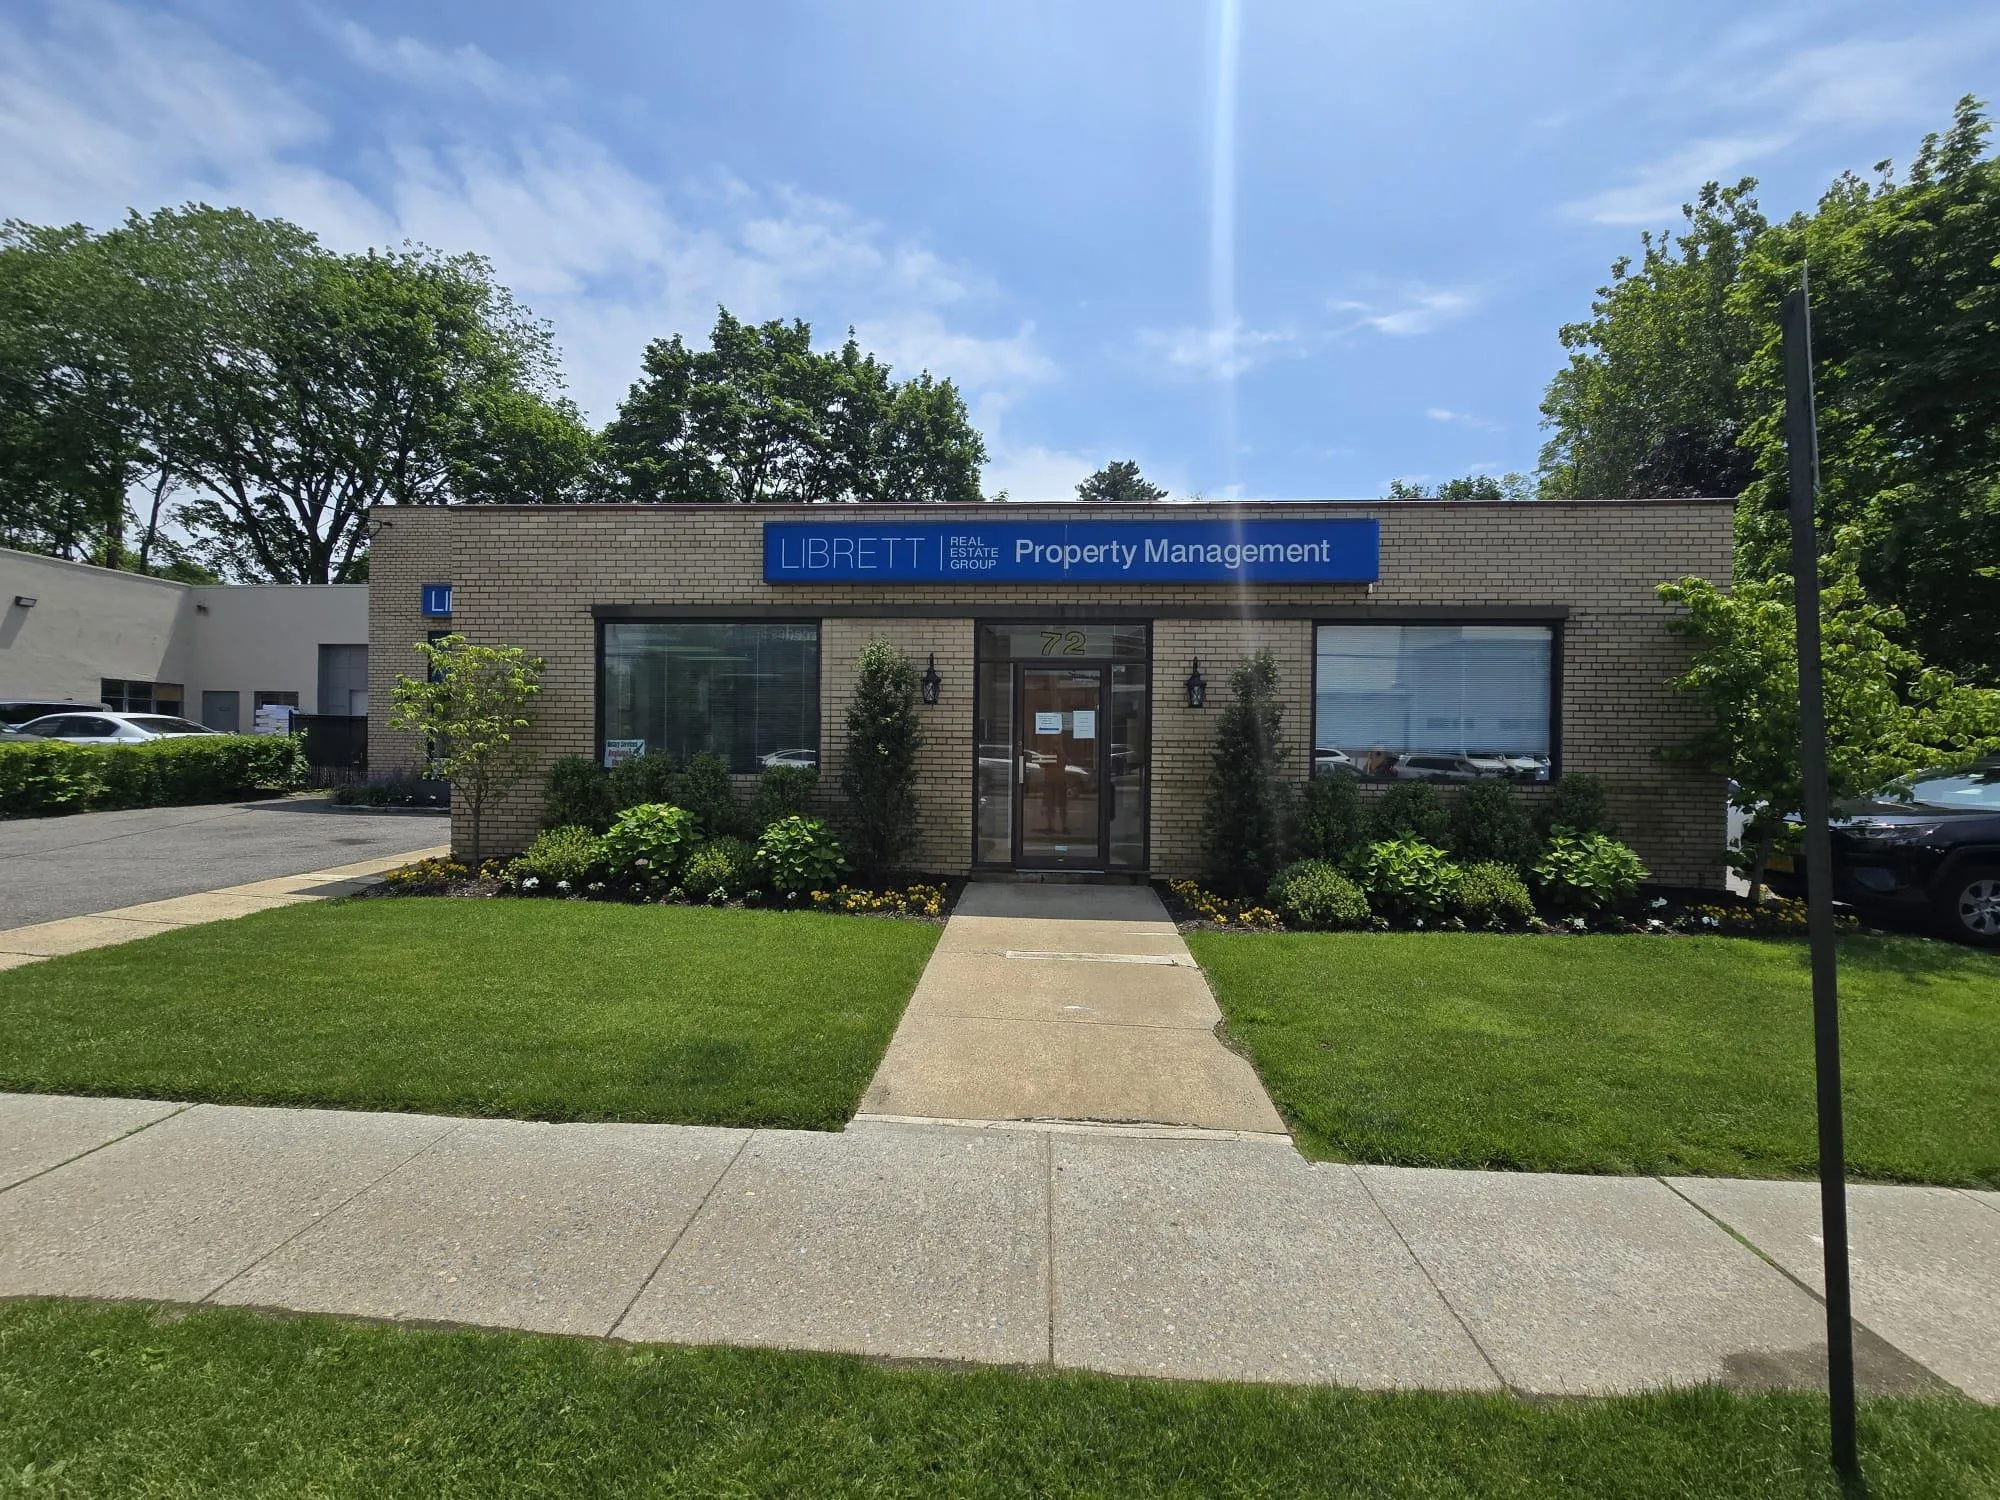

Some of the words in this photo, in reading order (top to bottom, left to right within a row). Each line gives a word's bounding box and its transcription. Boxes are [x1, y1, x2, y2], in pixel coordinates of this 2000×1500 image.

[950, 536, 985, 547] REAL
[950, 547, 999, 558] ESTATE
[781, 537, 926, 569] LIBRETT
[950, 559, 997, 569] GROUP
[1015, 538, 1137, 570] Property
[1144, 538, 1331, 569] Management
[431, 590, 452, 612] LI
[1040, 631, 1086, 656] 72
